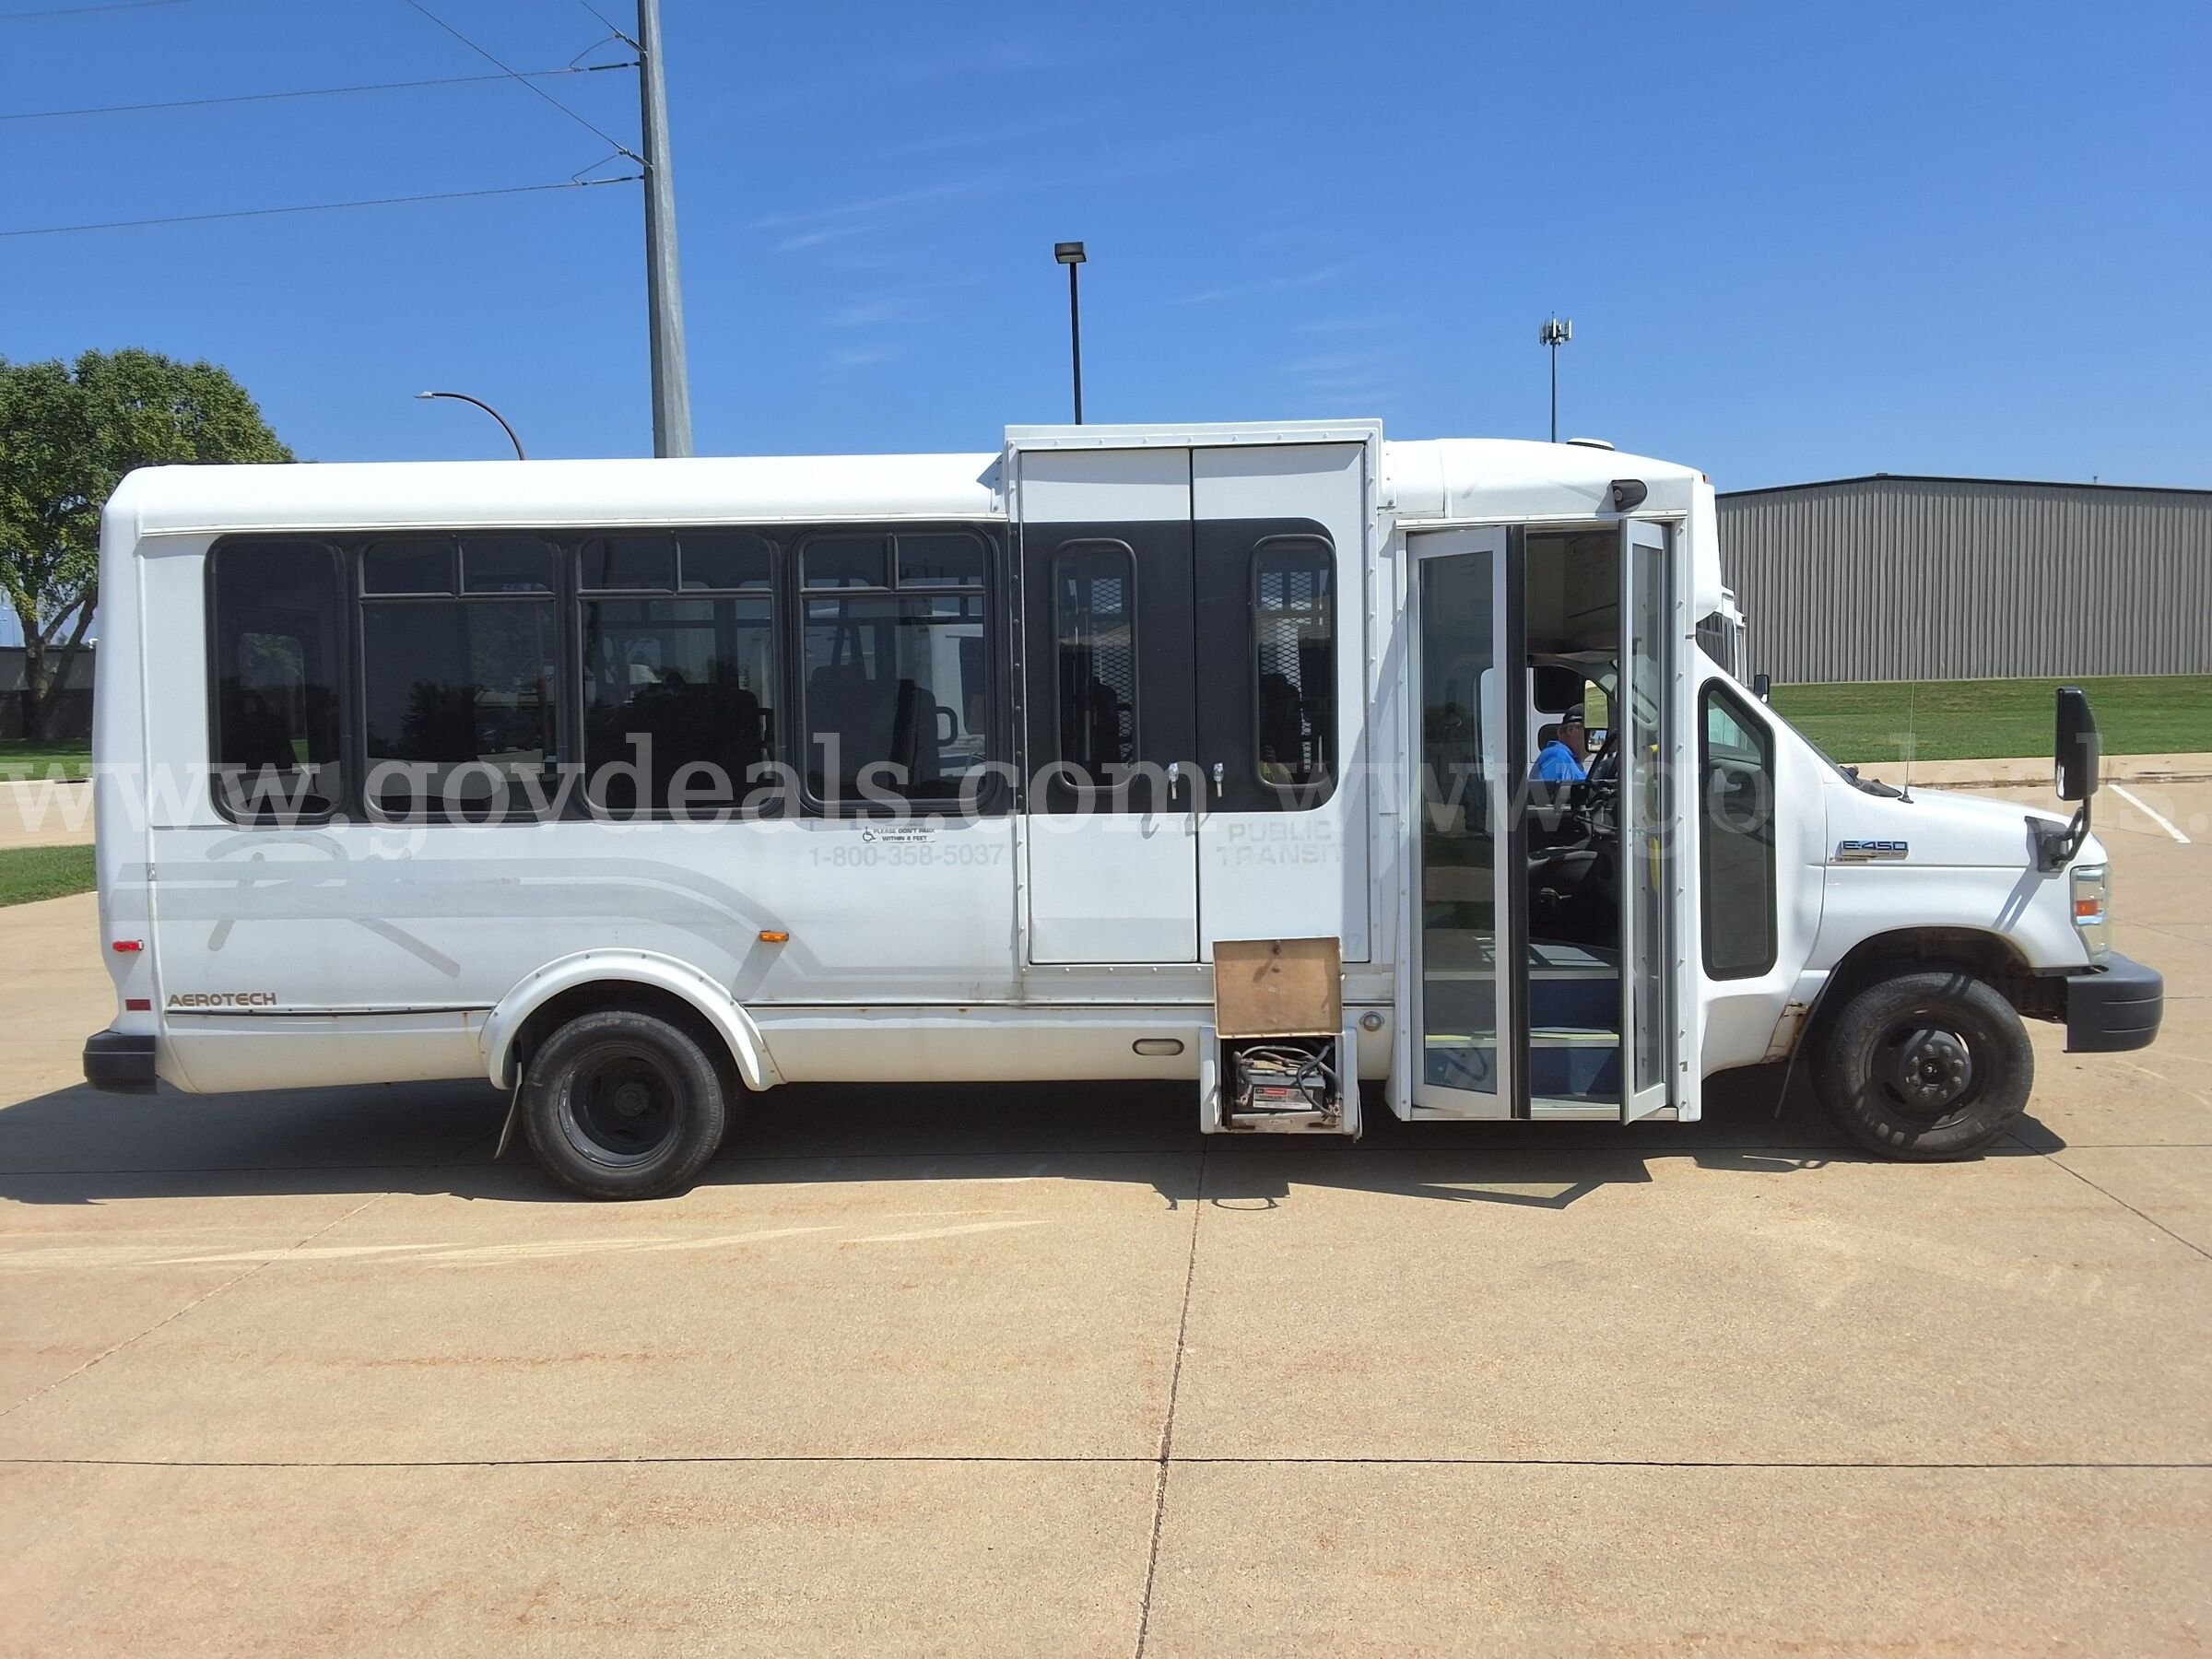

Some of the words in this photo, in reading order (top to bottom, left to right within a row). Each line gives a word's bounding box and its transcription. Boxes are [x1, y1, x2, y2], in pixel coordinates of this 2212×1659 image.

[1229, 820, 1332, 842] PUBLIC
[809, 843, 1006, 867] 1-800-358-5037
[1217, 842, 1347, 867] TRANSIT
[1842, 841, 1909, 851] E-450
[167, 992, 277, 1007] AEROTECH
